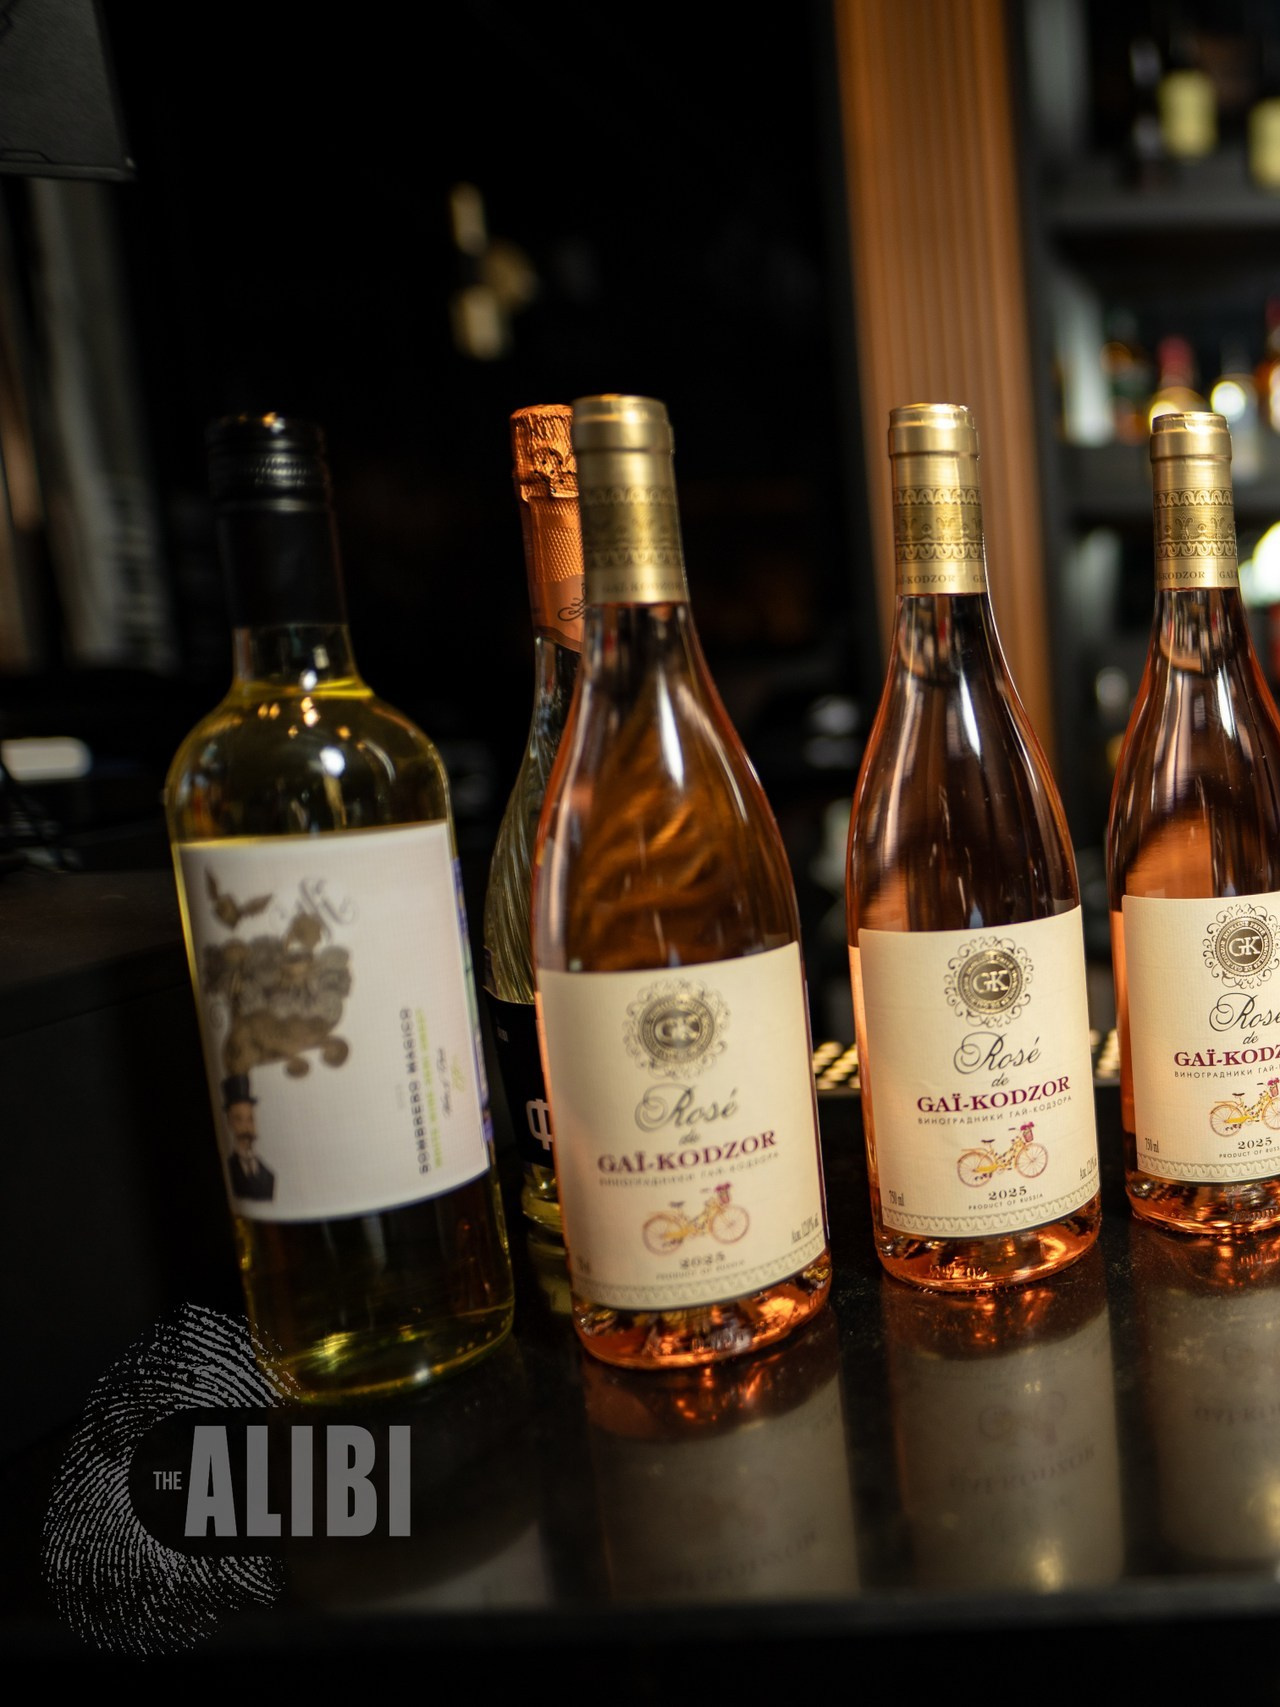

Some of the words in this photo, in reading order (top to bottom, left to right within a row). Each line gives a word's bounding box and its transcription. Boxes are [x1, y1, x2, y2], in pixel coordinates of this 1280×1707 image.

[1229, 936, 1260, 957] GK
[973, 970, 1009, 993] GK
[1242, 1031, 1259, 1045] de
[954, 1031, 1041, 1074] Rosé
[991, 1072, 1009, 1087] de
[1174, 1068, 1253, 1079] ВИНОГРАДНИКИ
[917, 1076, 1071, 1112] GAÏ-KODZOR
[634, 1082, 738, 1133] Rosé
[918, 1113, 1003, 1125] ВИНОГРАДНИКИ
[1009, 1095, 1072, 1119] ГАЙ-КОДЗОРА
[1237, 1137, 1273, 1150] 2025
[968, 1201, 1003, 1210] PRODUCT
[1020, 1193, 1044, 1204] RUSSIA
[988, 1186, 1027, 1201] 2025
